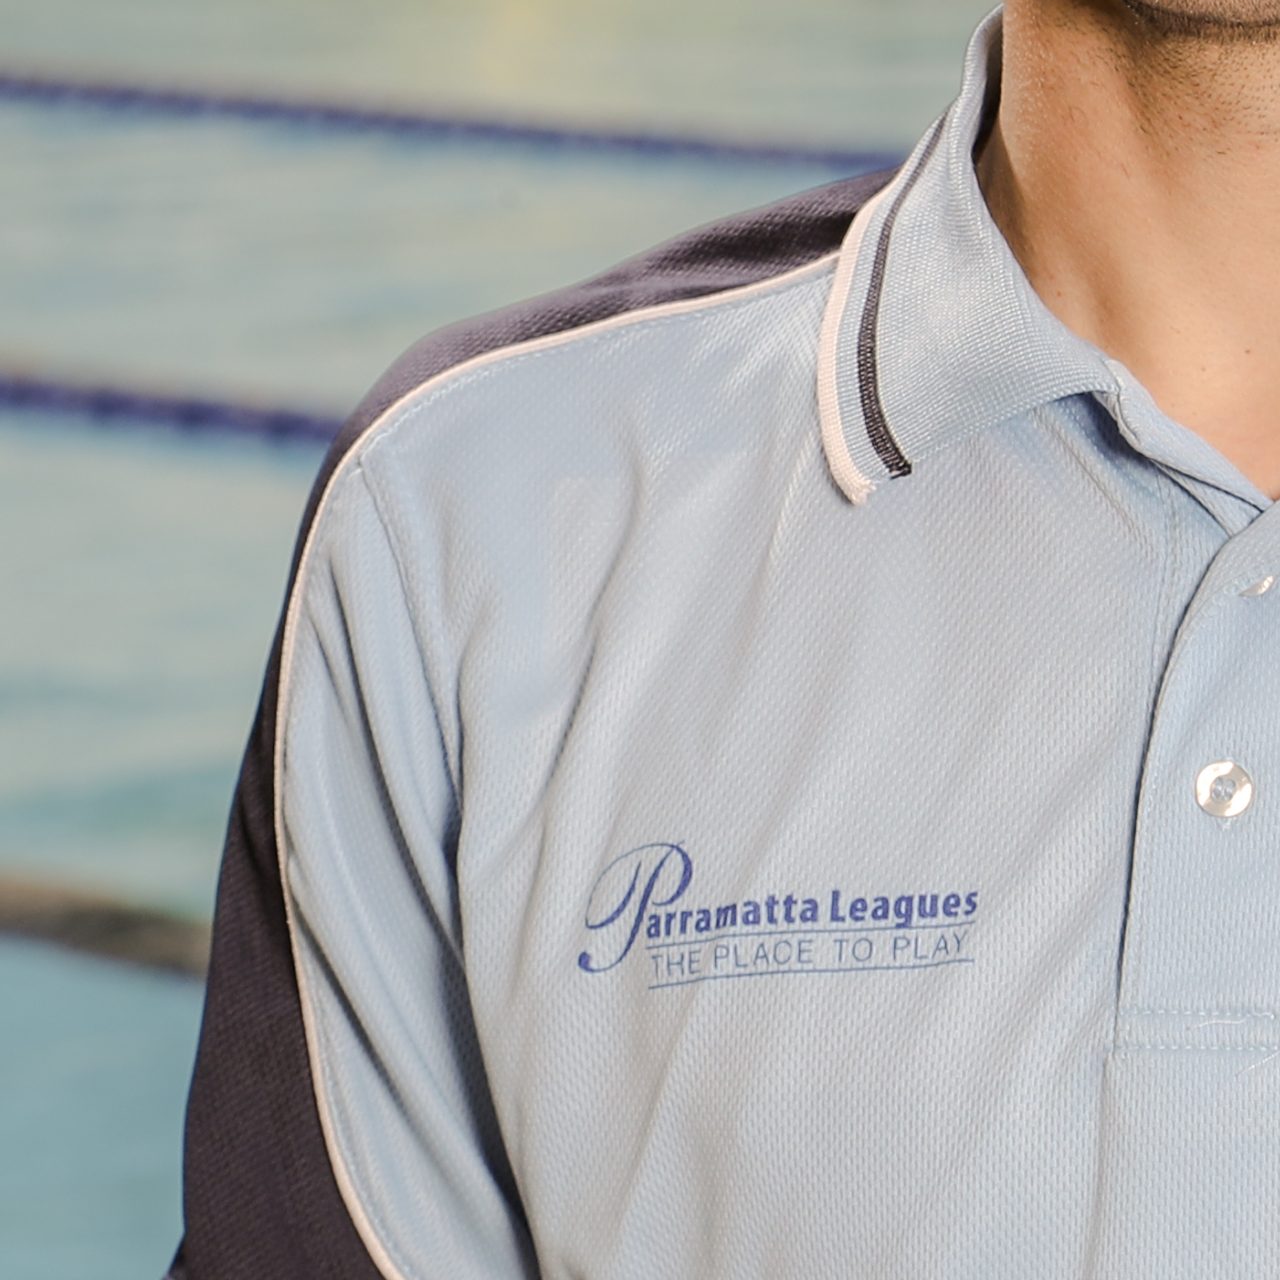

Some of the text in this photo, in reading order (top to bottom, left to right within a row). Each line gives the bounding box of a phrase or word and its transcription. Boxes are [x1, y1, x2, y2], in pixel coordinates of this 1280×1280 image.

[577, 840, 979, 974] Parramatta Leagues
[650, 931, 970, 978] THE PLACE TO PLAY
